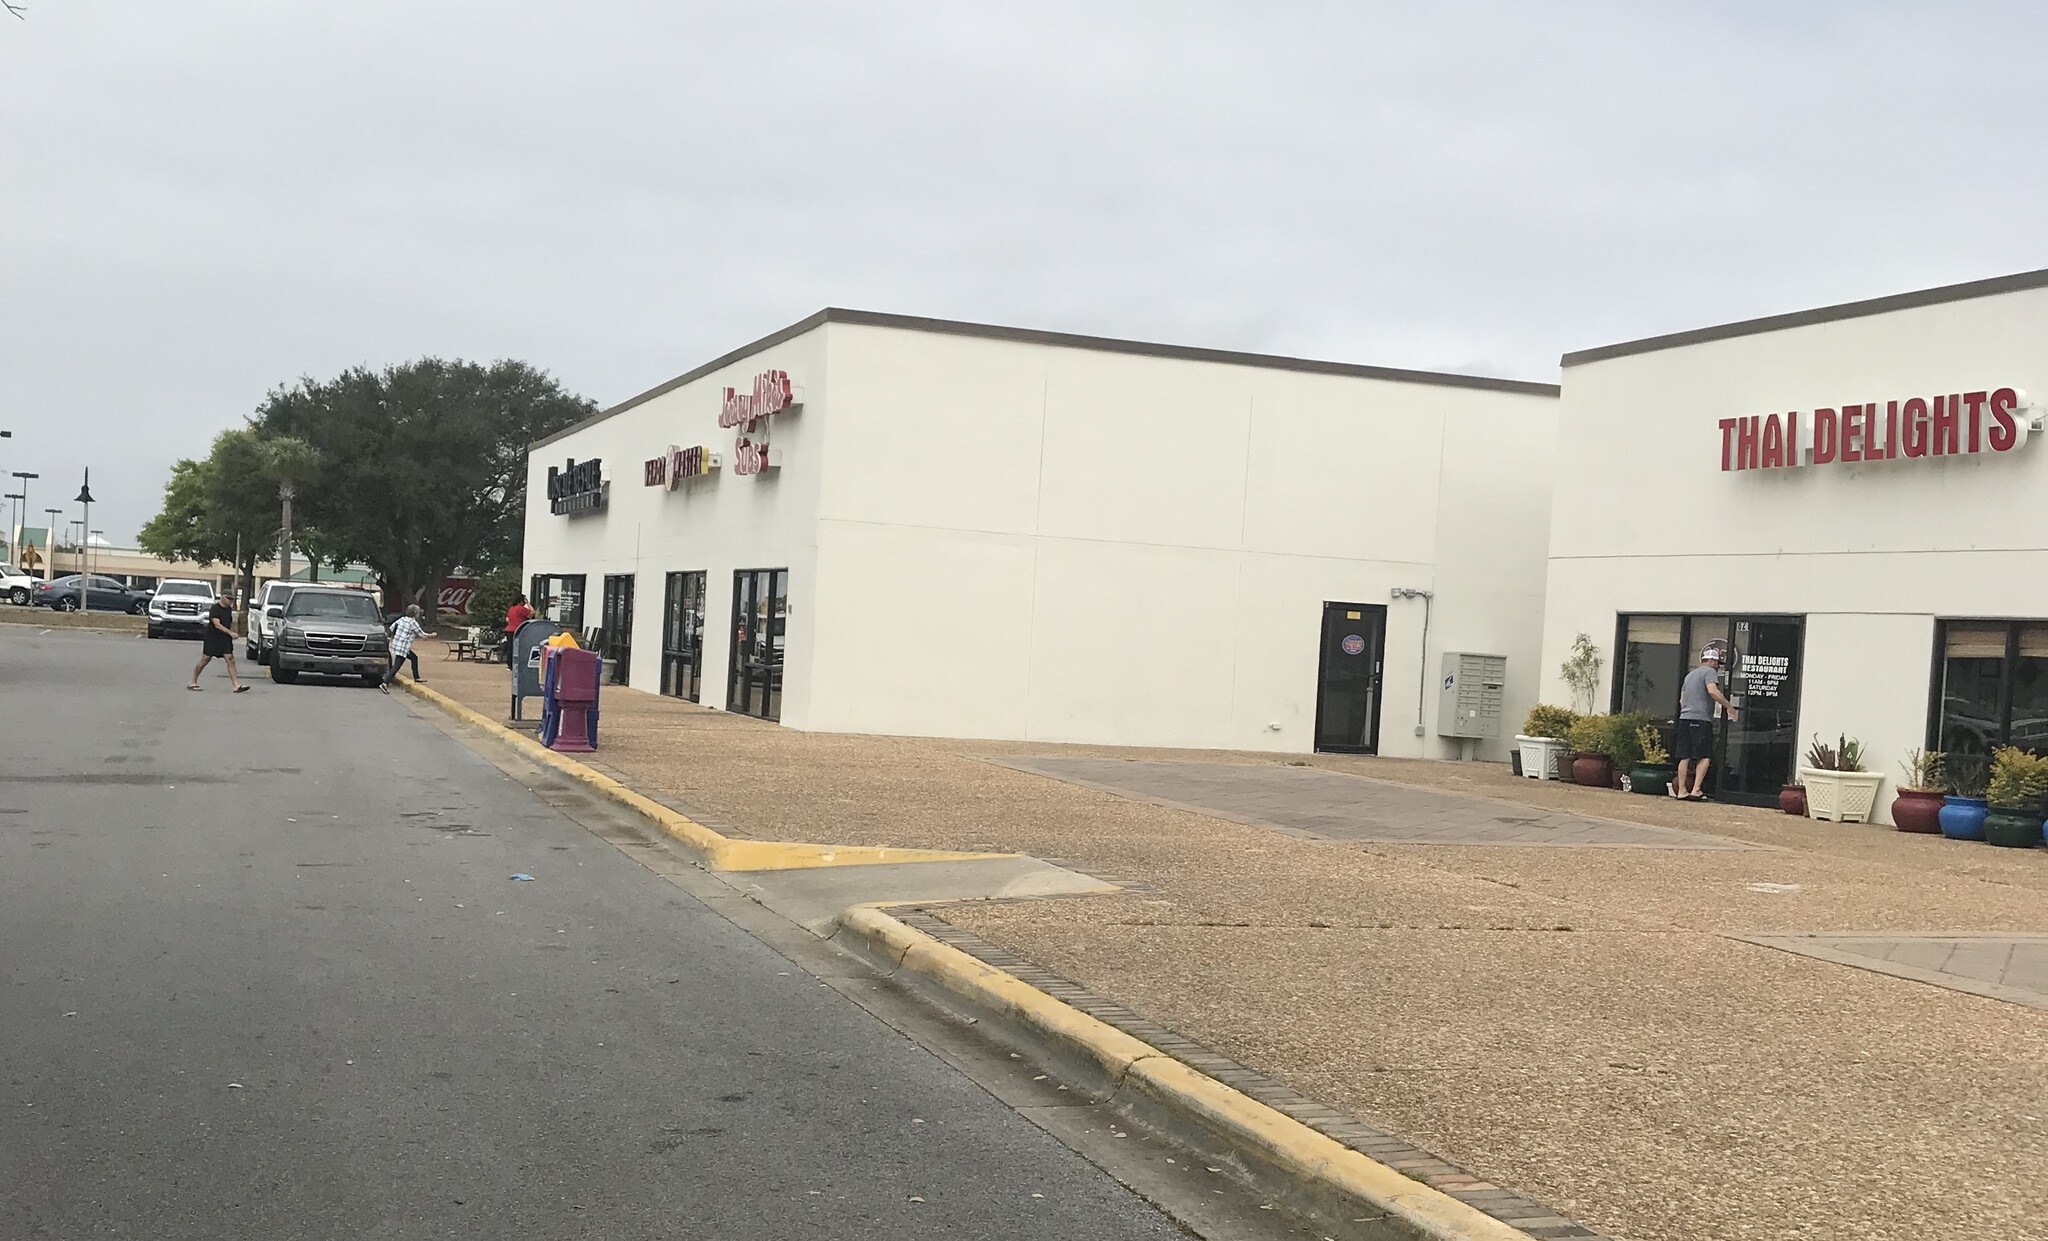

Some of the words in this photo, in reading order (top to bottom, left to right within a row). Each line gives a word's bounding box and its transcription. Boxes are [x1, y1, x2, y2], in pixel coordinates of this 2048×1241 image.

[1719, 411, 1798, 472] THAI
[1813, 387, 2019, 465] DELIGHTS
[1742, 655, 1756, 664] THAI
[1758, 656, 1789, 666] DELIGHTS
[1742, 665, 1787, 673] RESTAURANT
